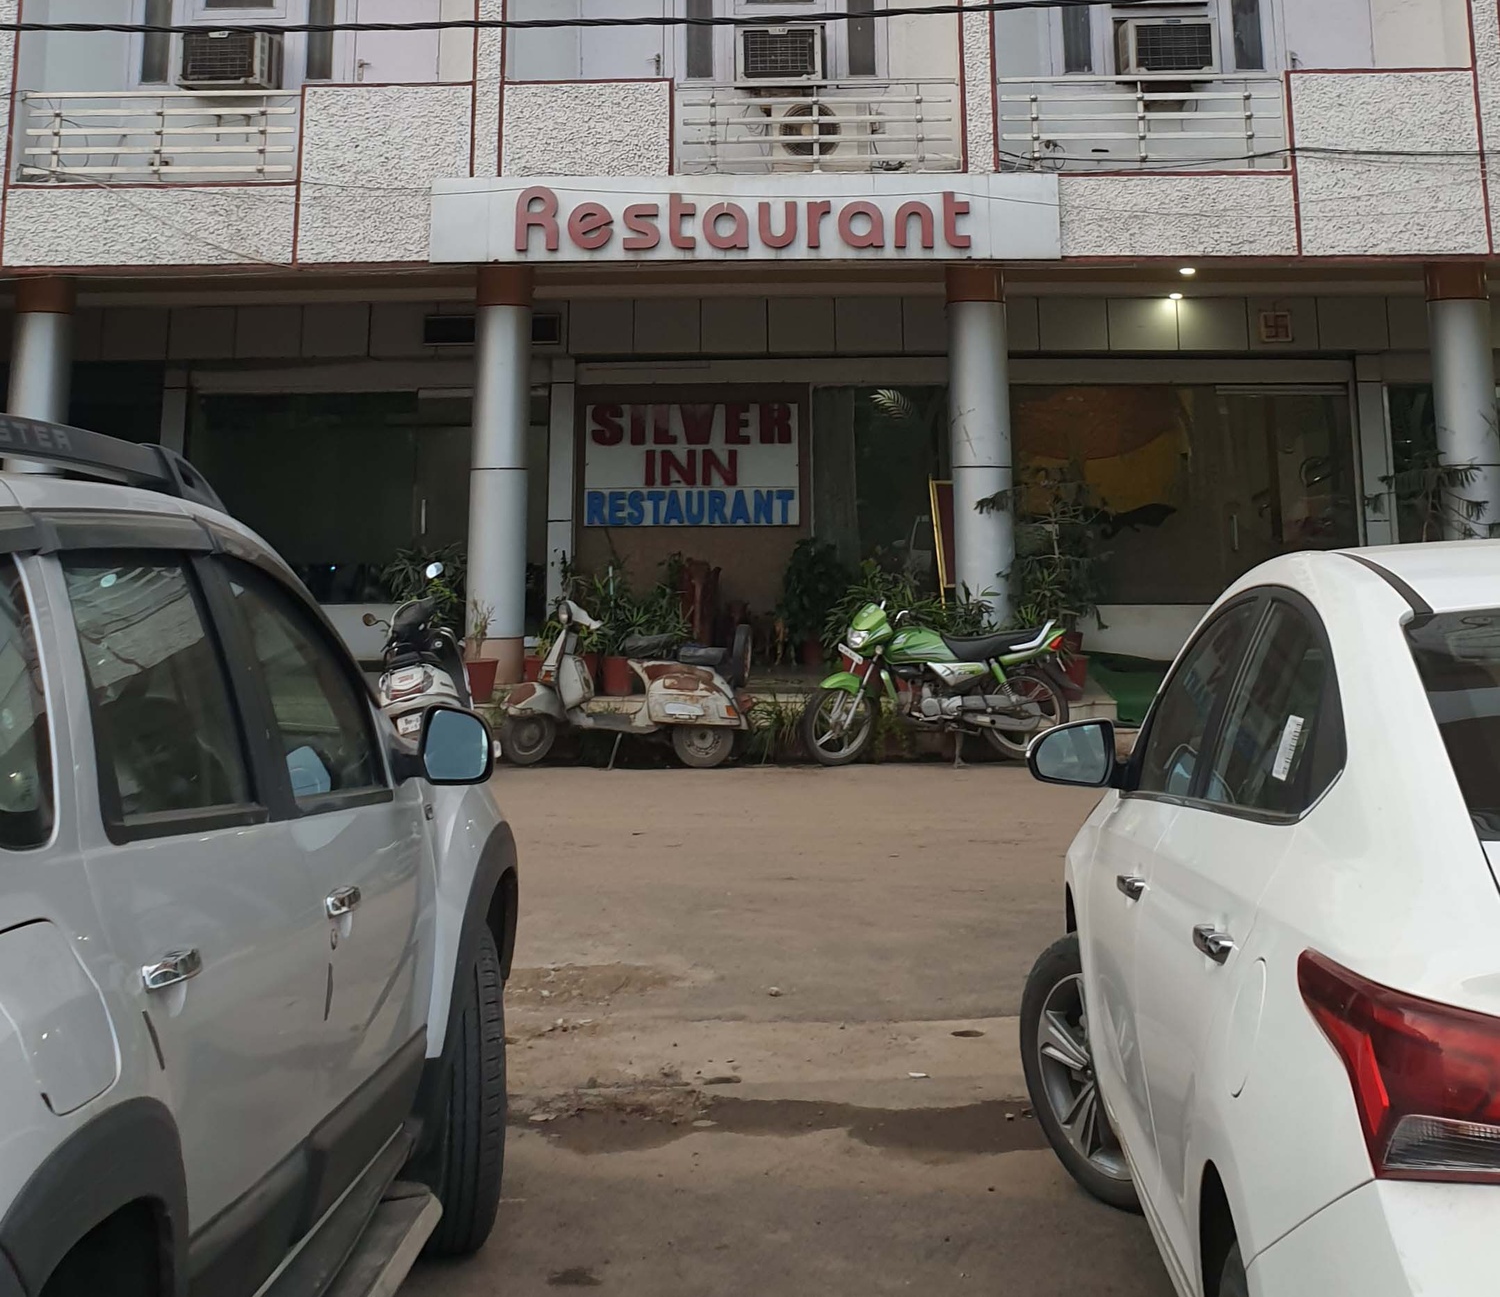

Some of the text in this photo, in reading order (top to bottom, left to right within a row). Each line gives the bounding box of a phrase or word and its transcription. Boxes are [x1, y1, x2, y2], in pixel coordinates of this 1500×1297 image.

[515, 185, 972, 251] Restaurant
[591, 403, 793, 446] SILVER
[644, 448, 738, 487] INN
[586, 489, 795, 526] RESTAURANT
